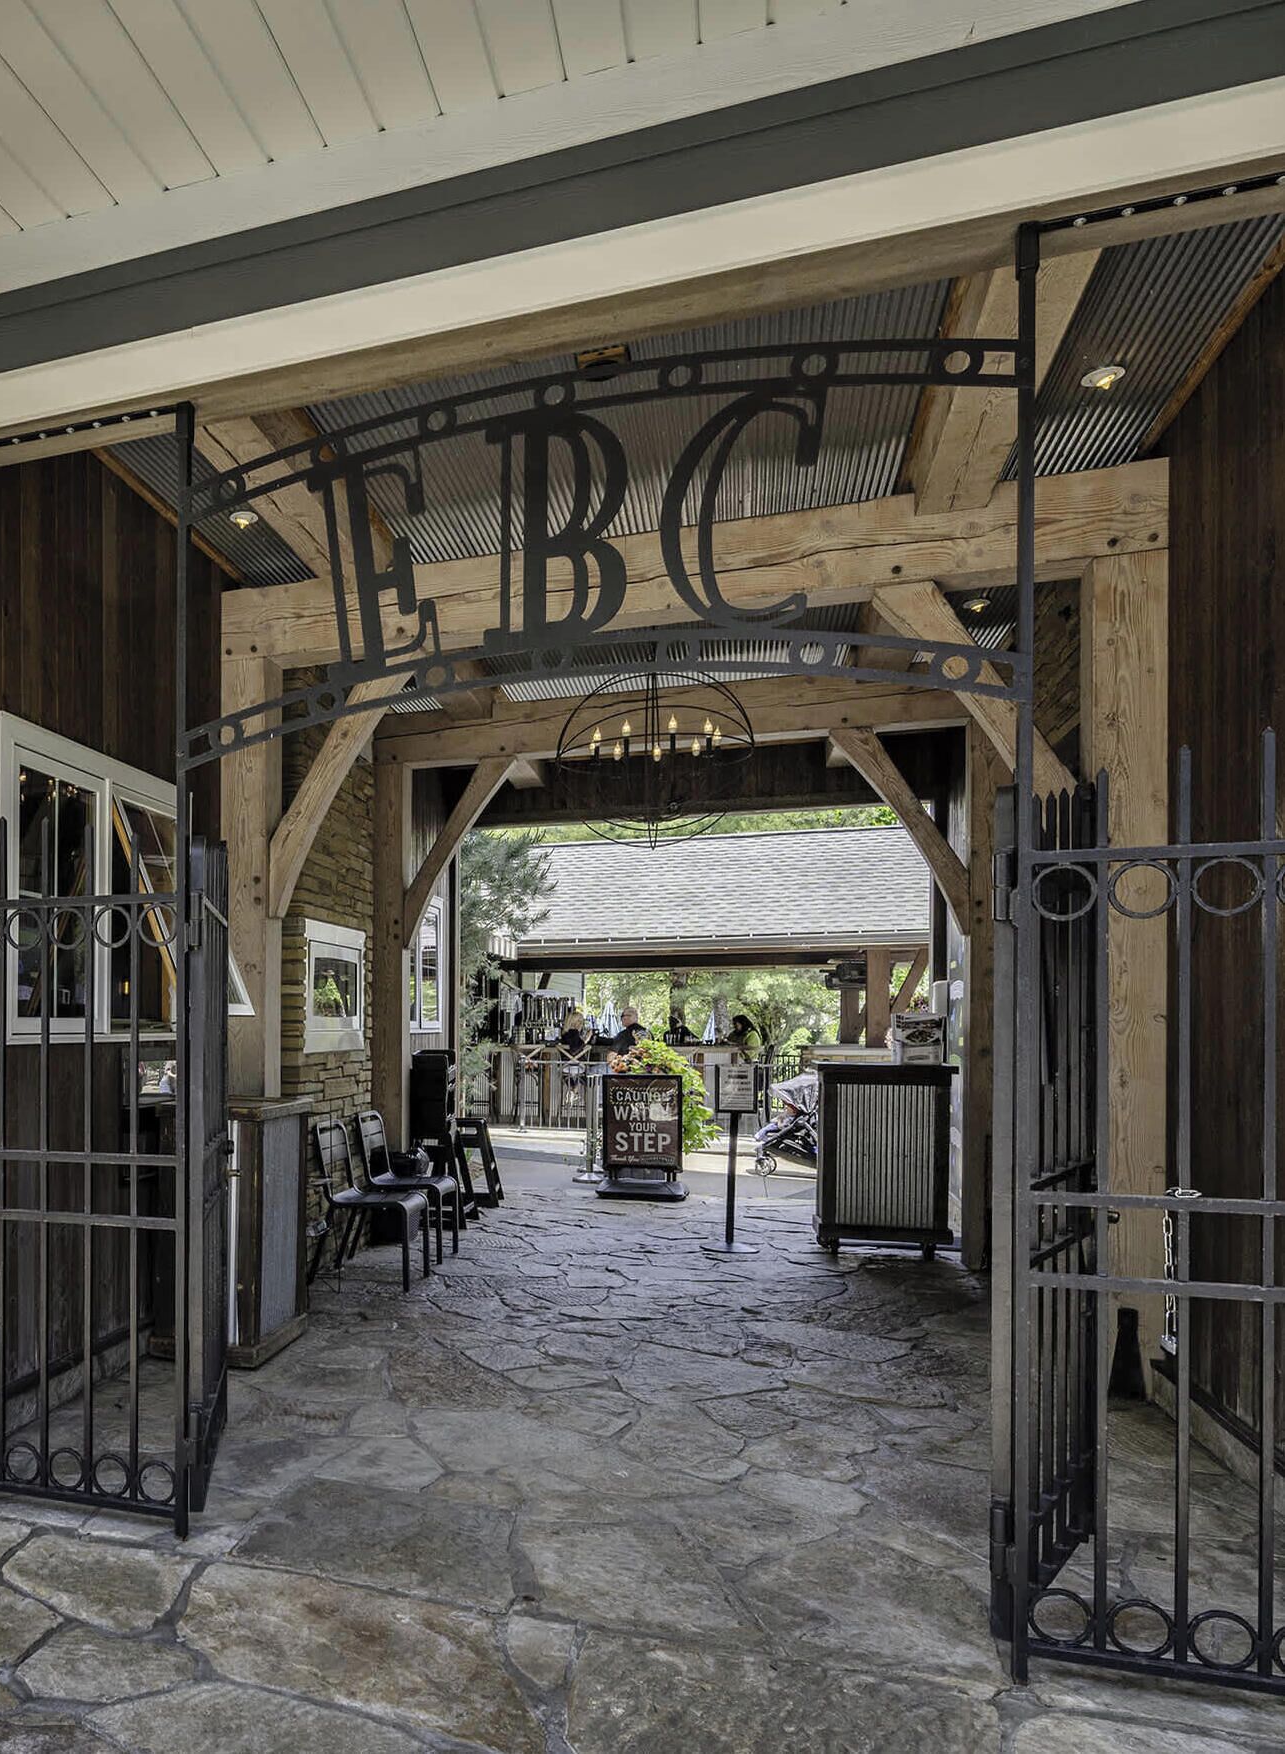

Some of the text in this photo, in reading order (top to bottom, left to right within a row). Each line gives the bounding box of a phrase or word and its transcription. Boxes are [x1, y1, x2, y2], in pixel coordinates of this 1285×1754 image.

[307, 388, 827, 690] EBC
[629, 1122, 657, 1132] YOUR
[615, 1132, 671, 1153] STEP
